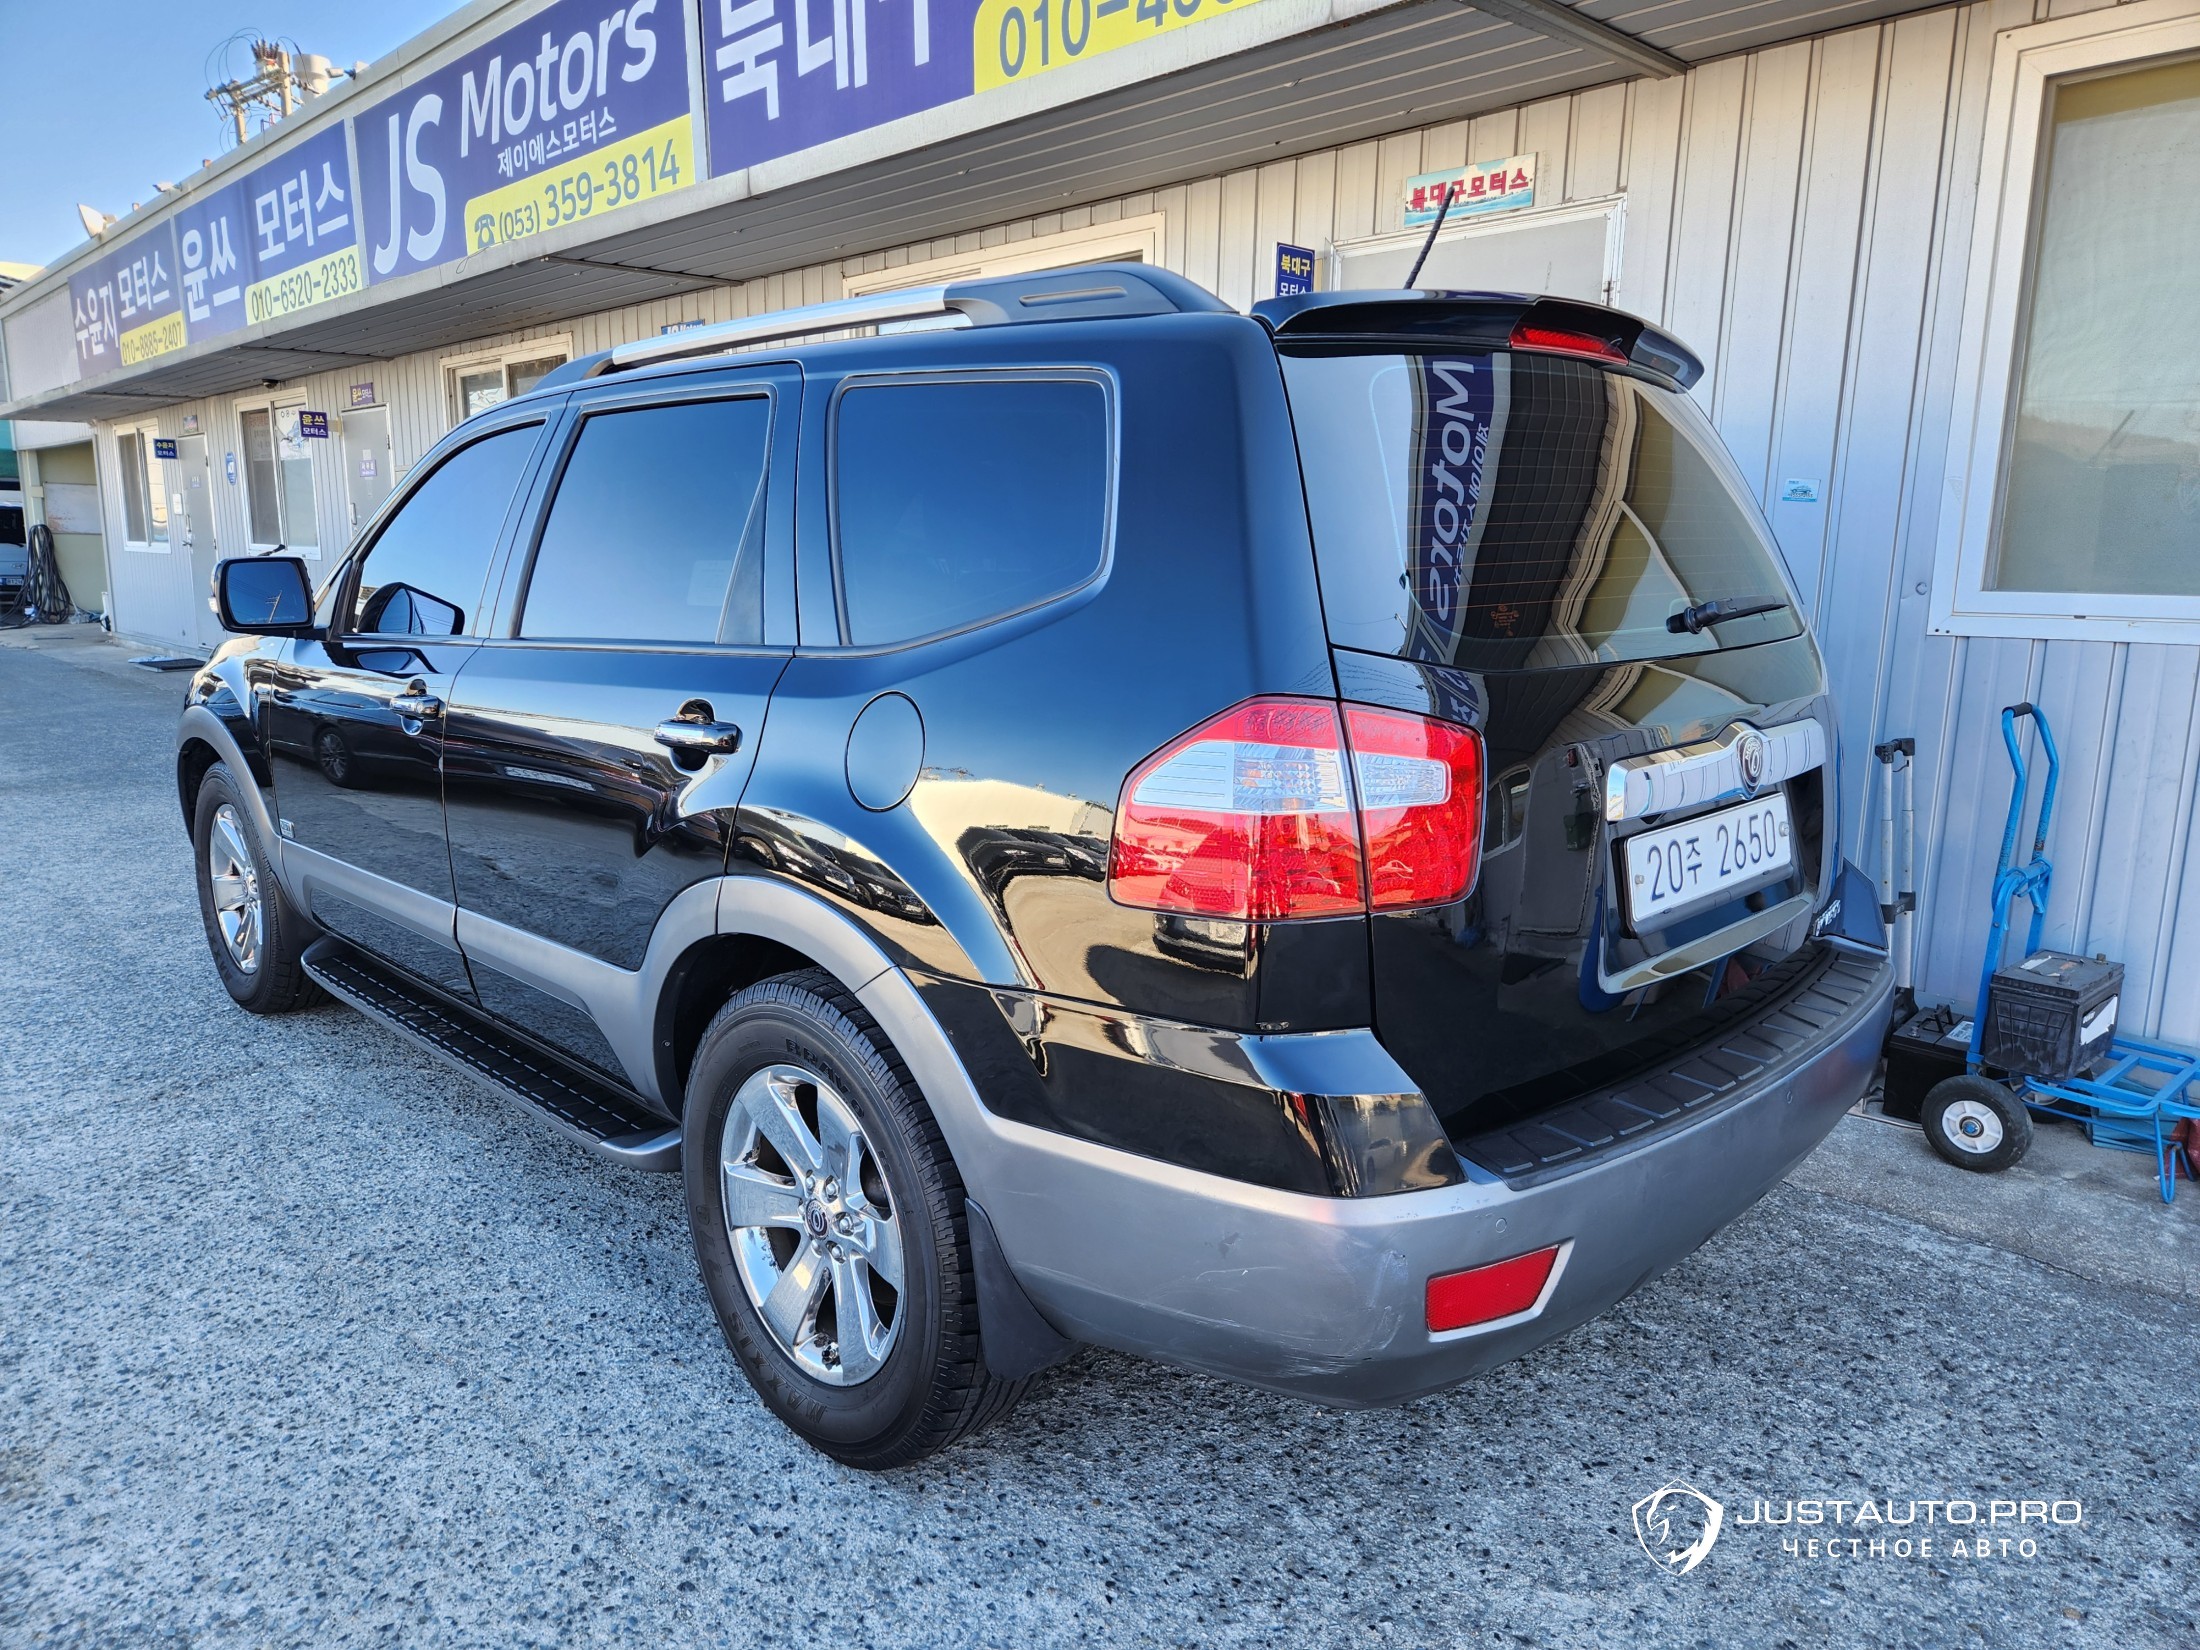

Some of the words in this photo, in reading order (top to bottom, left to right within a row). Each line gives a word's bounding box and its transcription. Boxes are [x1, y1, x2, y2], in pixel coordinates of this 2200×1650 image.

[716, 0, 930, 121] 북대
[1000, 0, 1239, 77] 010-
[373, 93, 446, 275] JS
[461, 0, 657, 158] Motors
[497, 106, 617, 178] 제이에스모터스
[499, 200, 541, 242] (053)
[544, 138, 680, 227] 359-3814
[1409, 167, 1529, 213] 북대구모터스
[182, 216, 241, 323] 윤쓰
[256, 161, 349, 262] 모터스
[1280, 253, 1311, 277] 북대구
[74, 280, 120, 360] 수윤지
[117, 251, 170, 319] 모터스
[250, 253, 358, 322] 010-6520-2333
[121, 320, 182, 365] 010-8885-2407
[302, 426, 327, 436] 모터스
[1647, 835, 1702, 901] 20주
[1716, 808, 1777, 878] 2650
[785, 1038, 866, 1120] BRAVO
[727, 1311, 827, 1425] MAXXIS
